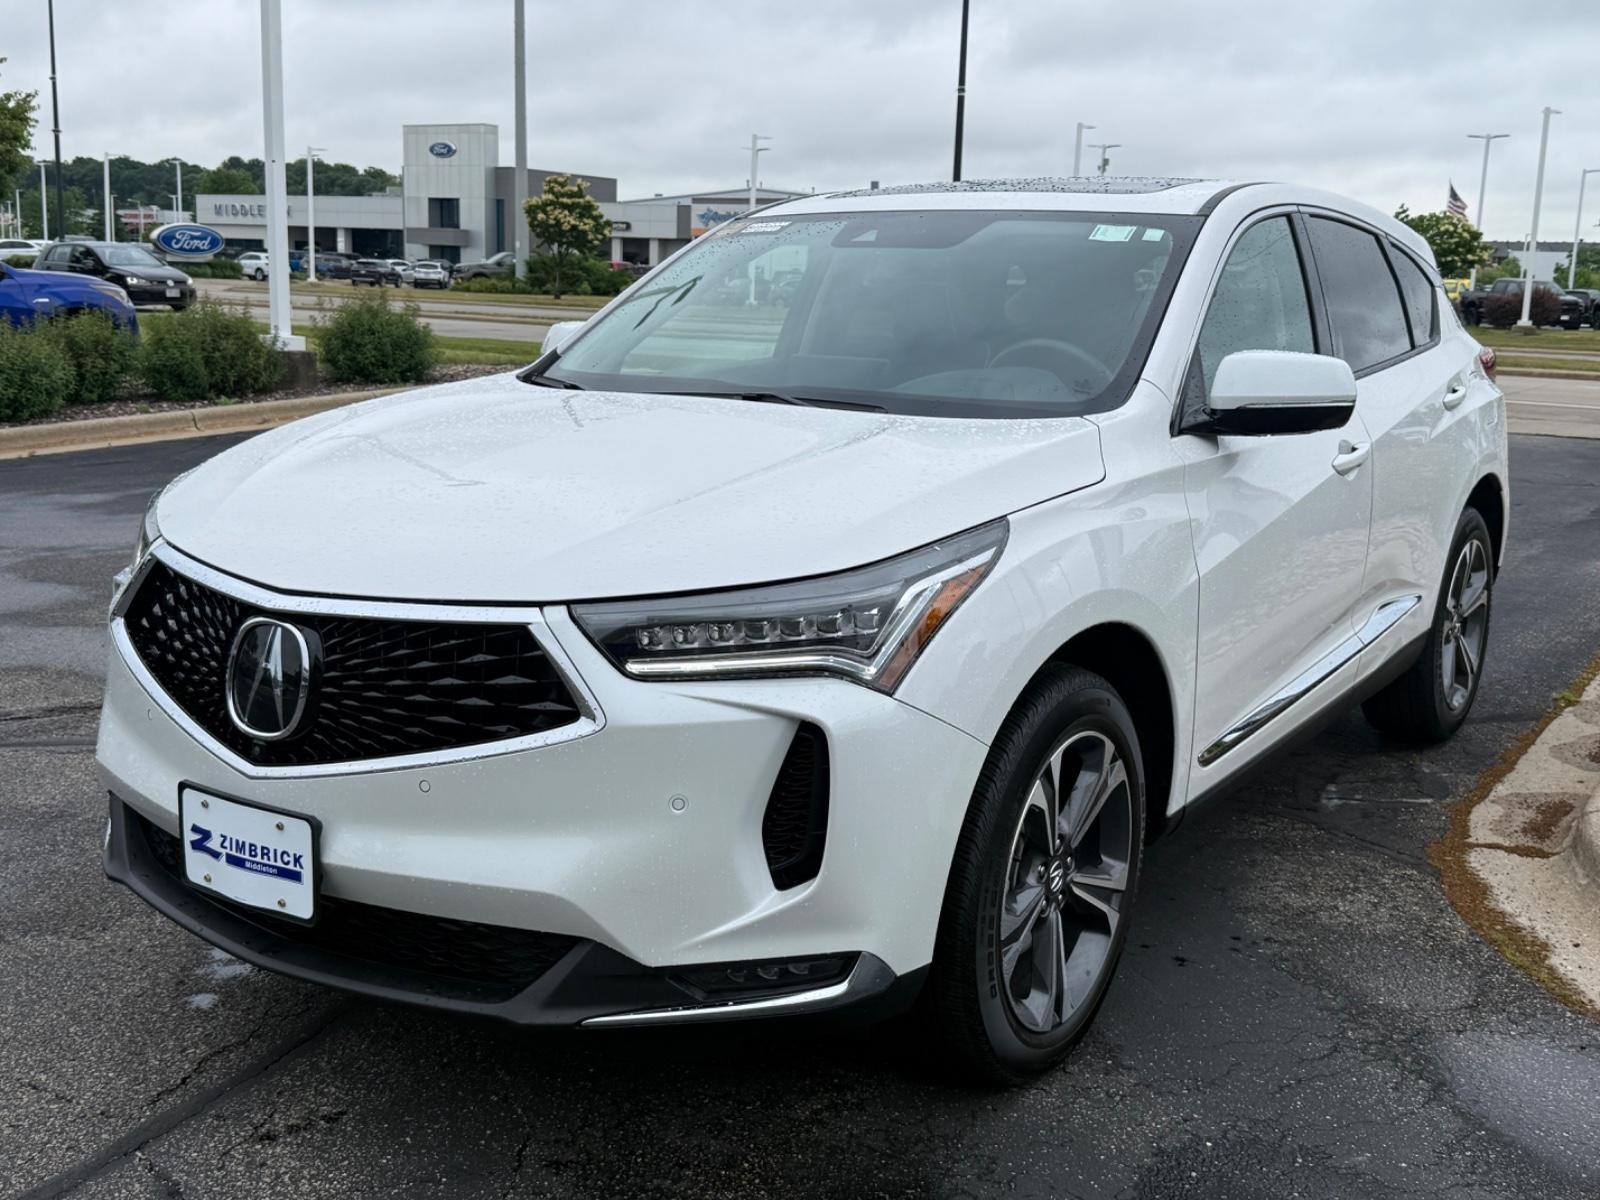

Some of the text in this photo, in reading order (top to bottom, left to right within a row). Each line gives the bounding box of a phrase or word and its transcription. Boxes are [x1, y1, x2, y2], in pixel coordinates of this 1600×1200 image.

[171, 230, 212, 250] Ford
[219, 834, 304, 870] ZIMBRICK
[244, 860, 279, 875] Middleton
